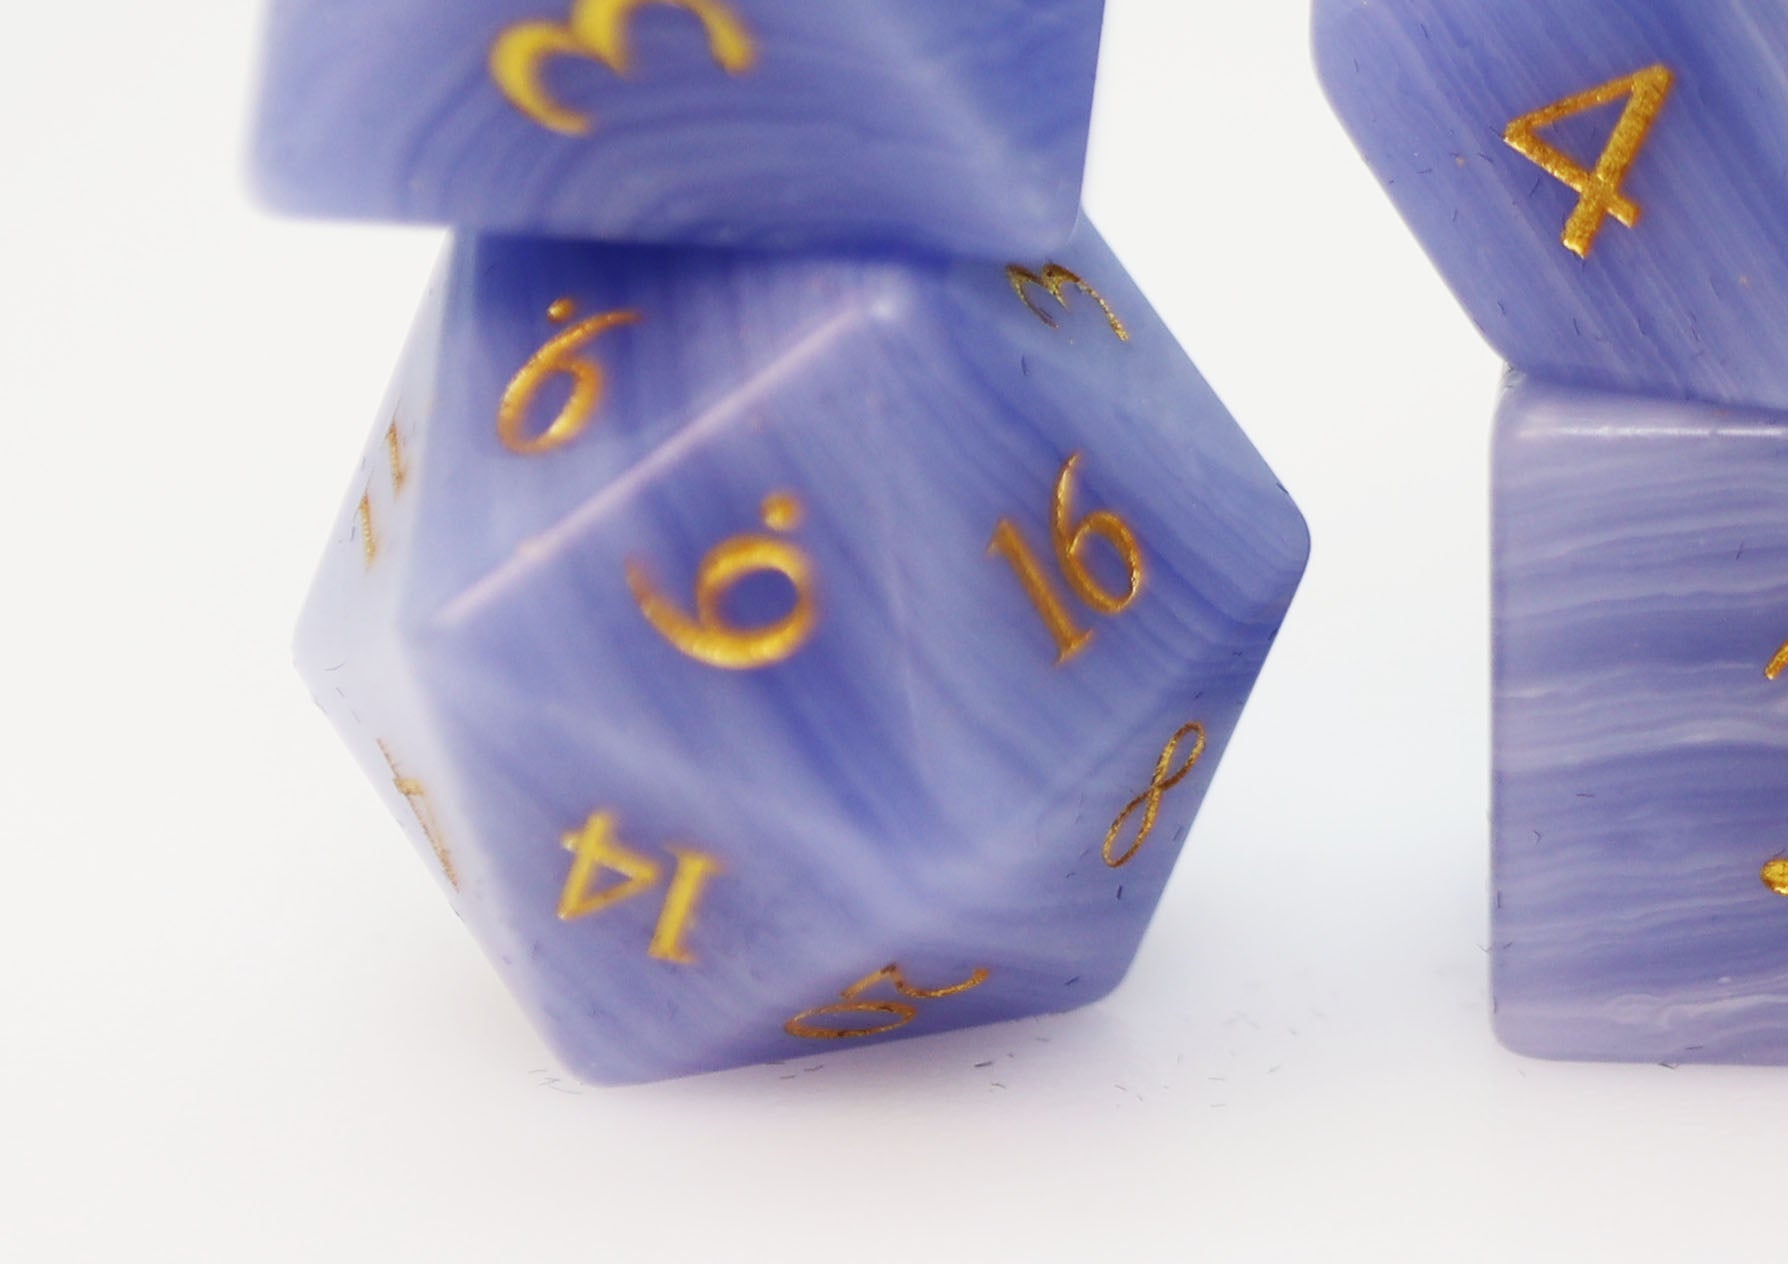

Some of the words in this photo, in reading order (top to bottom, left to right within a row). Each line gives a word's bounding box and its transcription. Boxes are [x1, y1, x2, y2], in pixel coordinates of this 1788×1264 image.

[1501, 62, 1676, 259] 4
[1006, 262, 1130, 342] 3
[987, 450, 1146, 666] 16
[1100, 720, 1208, 868] 8
[554, 809, 725, 965] 14
[783, 963, 990, 1040] 20
